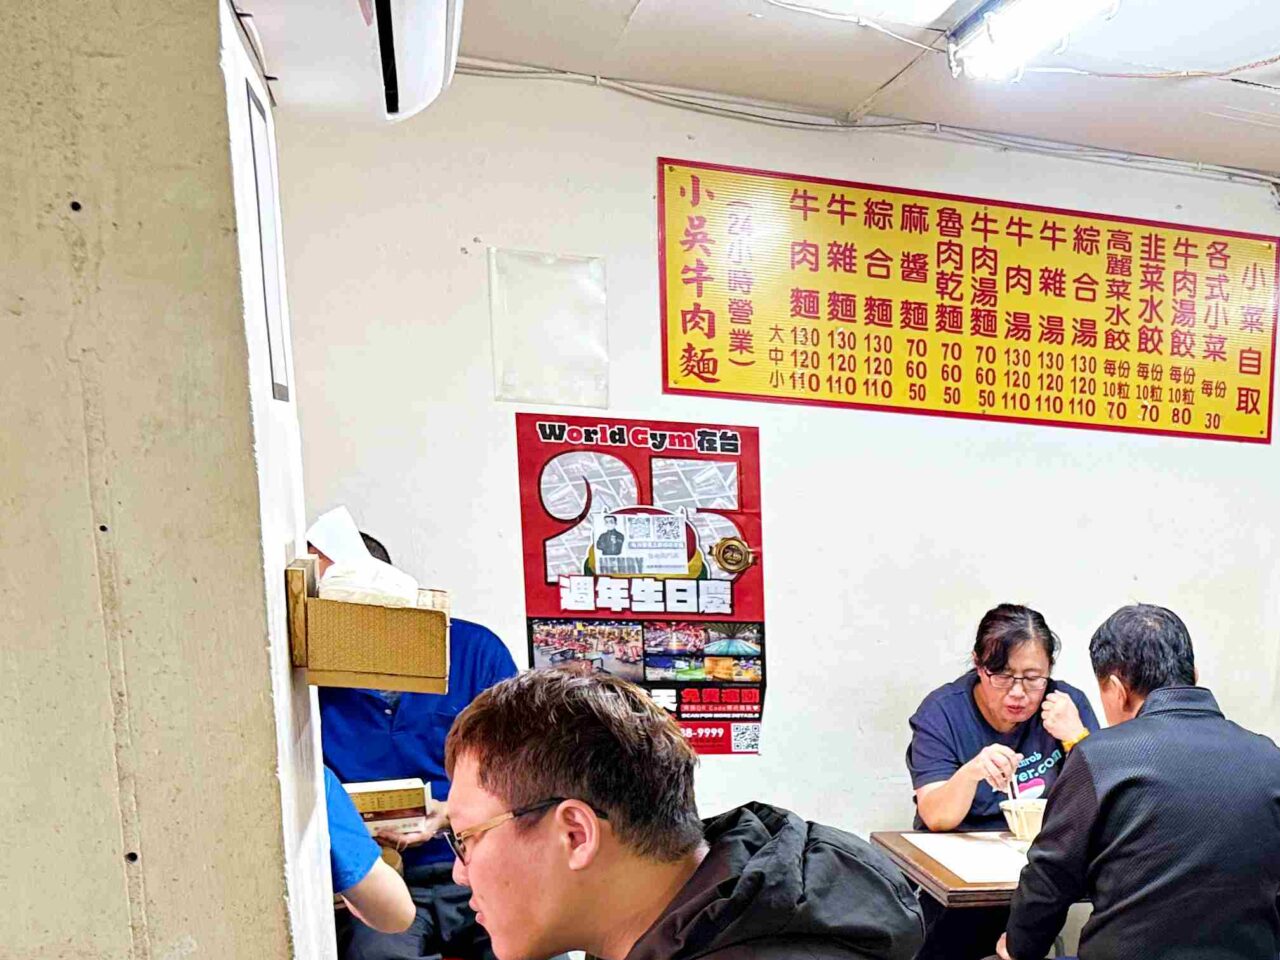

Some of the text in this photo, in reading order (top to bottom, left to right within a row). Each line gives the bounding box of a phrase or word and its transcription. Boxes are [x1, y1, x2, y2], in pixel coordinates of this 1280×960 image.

[679, 175, 720, 383] 小吳牛肉麵
[790, 188, 820, 321] 牛肉麵
[827, 194, 857, 323] 牛雜麵
[863, 198, 893, 329] 綜合麵
[900, 204, 929, 331] 麻醬麵
[935, 207, 964, 335] 魯肉乾麵
[970, 211, 999, 339] 牛肉湯麵
[1004, 216, 1033, 343] 牛肉湯
[1038, 221, 1067, 346] 牛雜湯
[1071, 224, 1100, 348] 綜合湯
[1104, 229, 1133, 352] 高麗菜水餃
[1137, 233, 1166, 356] 韭菜水餃
[1170, 237, 1199, 359] 牛肉湯餃
[1202, 241, 1231, 362] 各式小菜
[769, 323, 1097, 374] 大 130 130 130 70 70 70 130 130 130
[769, 347, 1096, 395] 中 120 120 120 60 60 60 120 120 120
[769, 369, 1096, 416] 小 110 110 110 50 50 50 110 110 110
[1103, 381, 1195, 405] 10粒 10粒 10粒
[1104, 359, 1196, 385] 每份 每份 每份
[1201, 379, 1227, 398] 每份
[1236, 262, 1267, 416] 小菜自取
[537, 422, 741, 454] World Gym 在台
[1107, 401, 1191, 425] 70 70 80
[1205, 413, 1220, 429] 30
